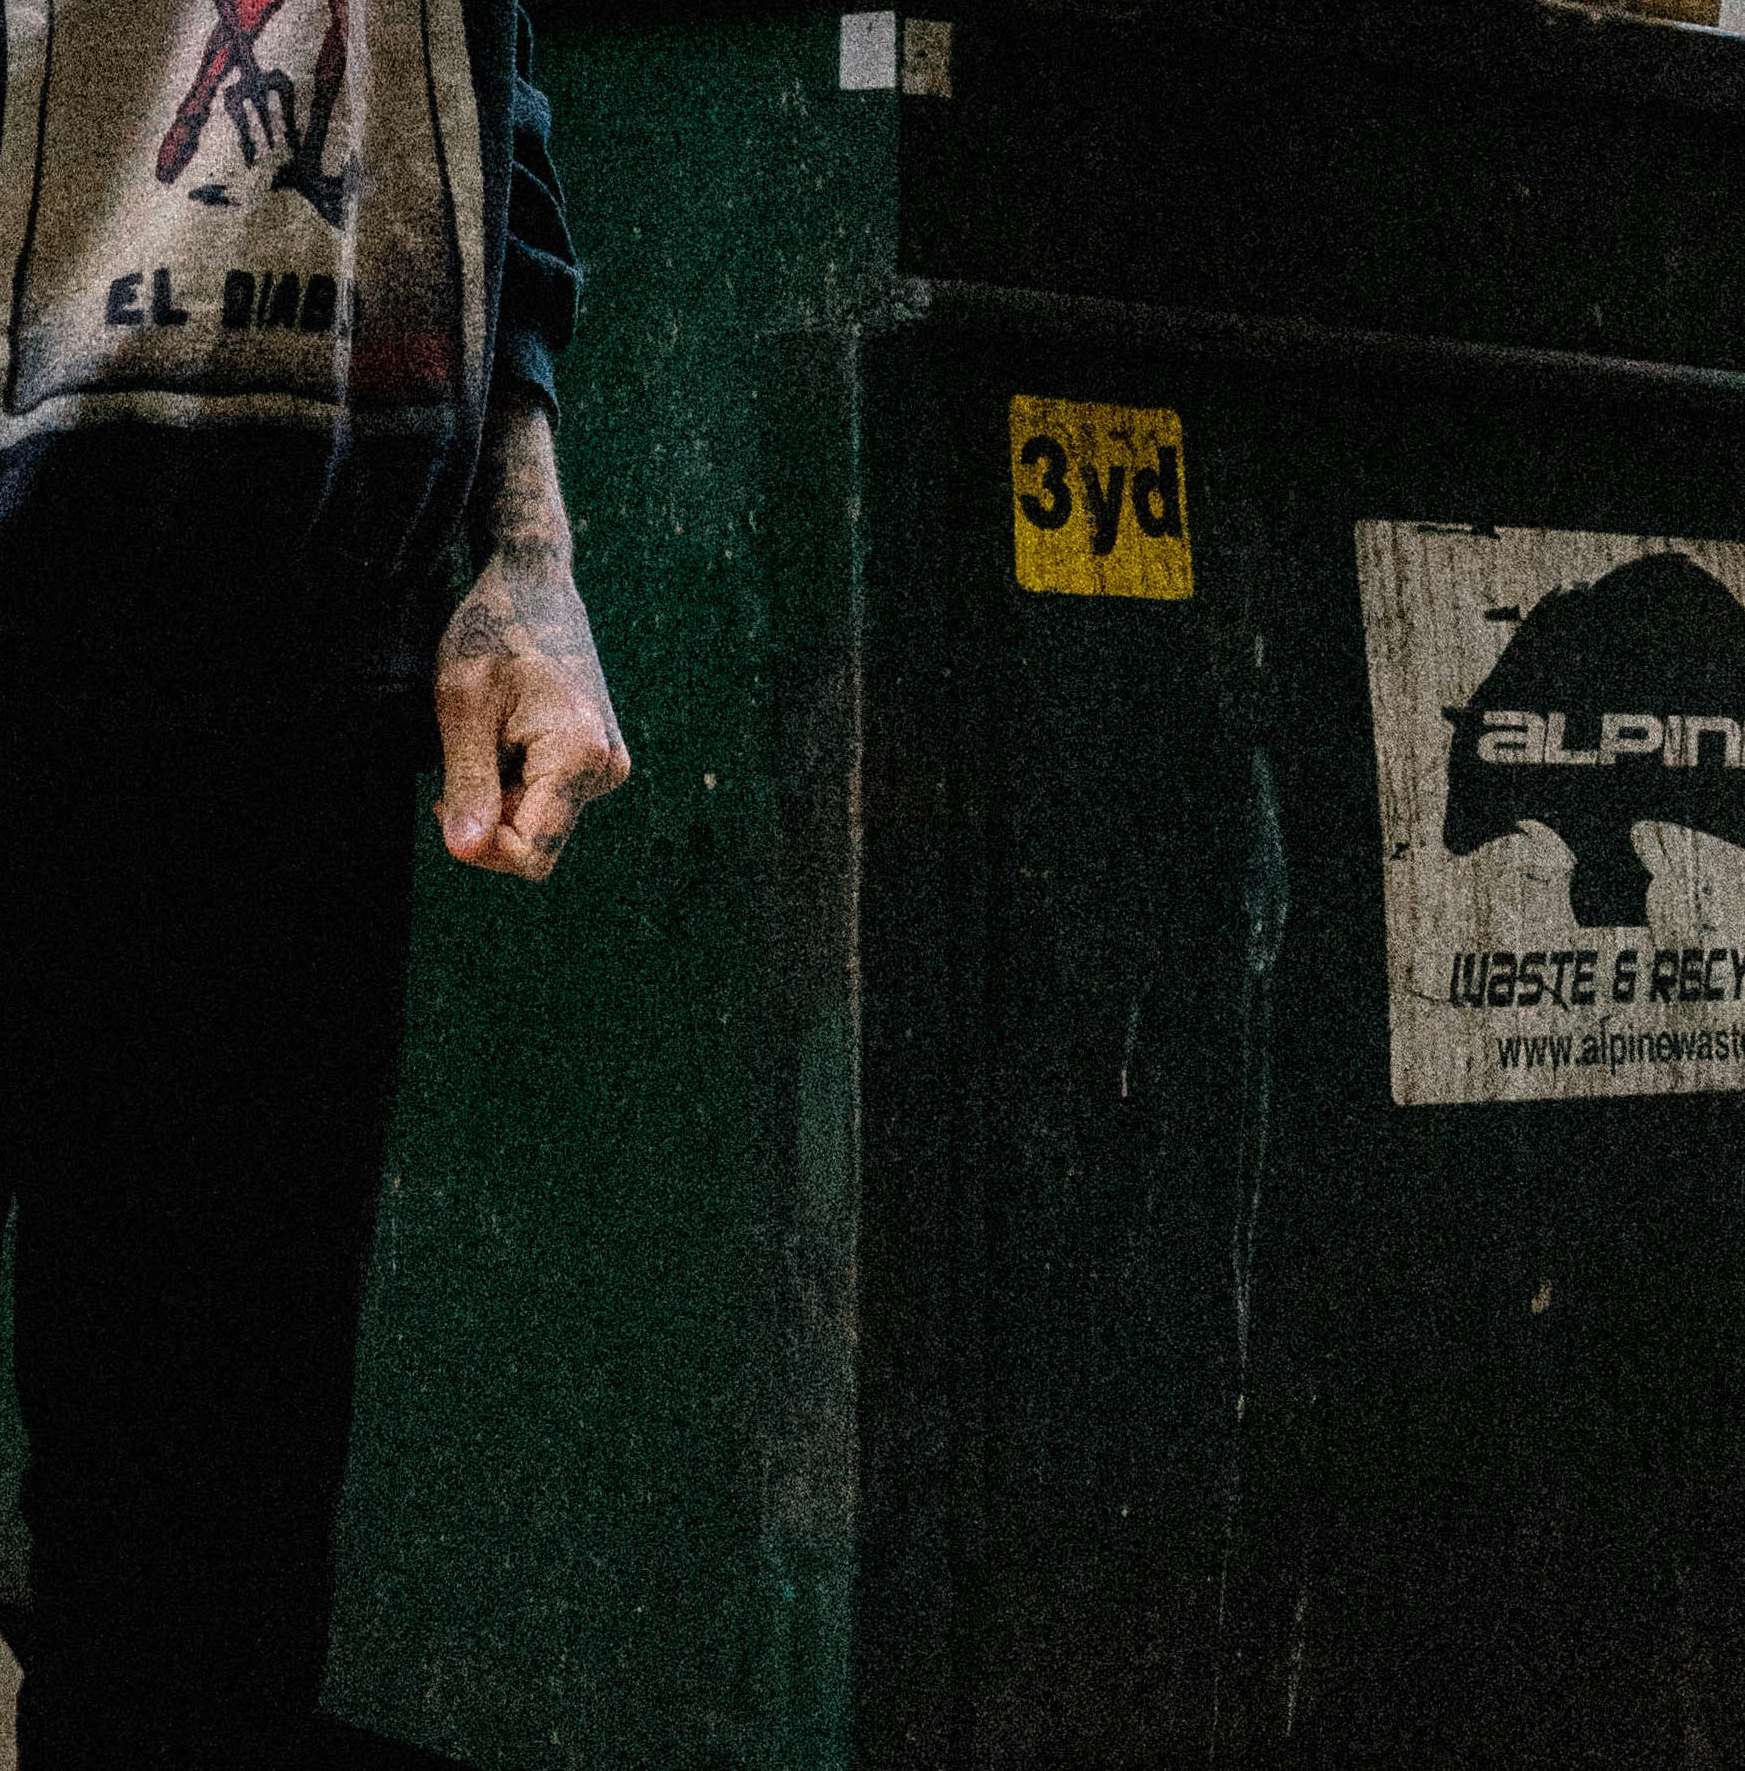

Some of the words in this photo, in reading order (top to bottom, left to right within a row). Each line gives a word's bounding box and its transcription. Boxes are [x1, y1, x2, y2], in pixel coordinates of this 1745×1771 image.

[106, 267, 188, 326] EL
[221, 269, 336, 331] DIAB
[1019, 434, 1181, 556] 3yd
[1498, 1016, 1745, 1077] www.alpinewast
